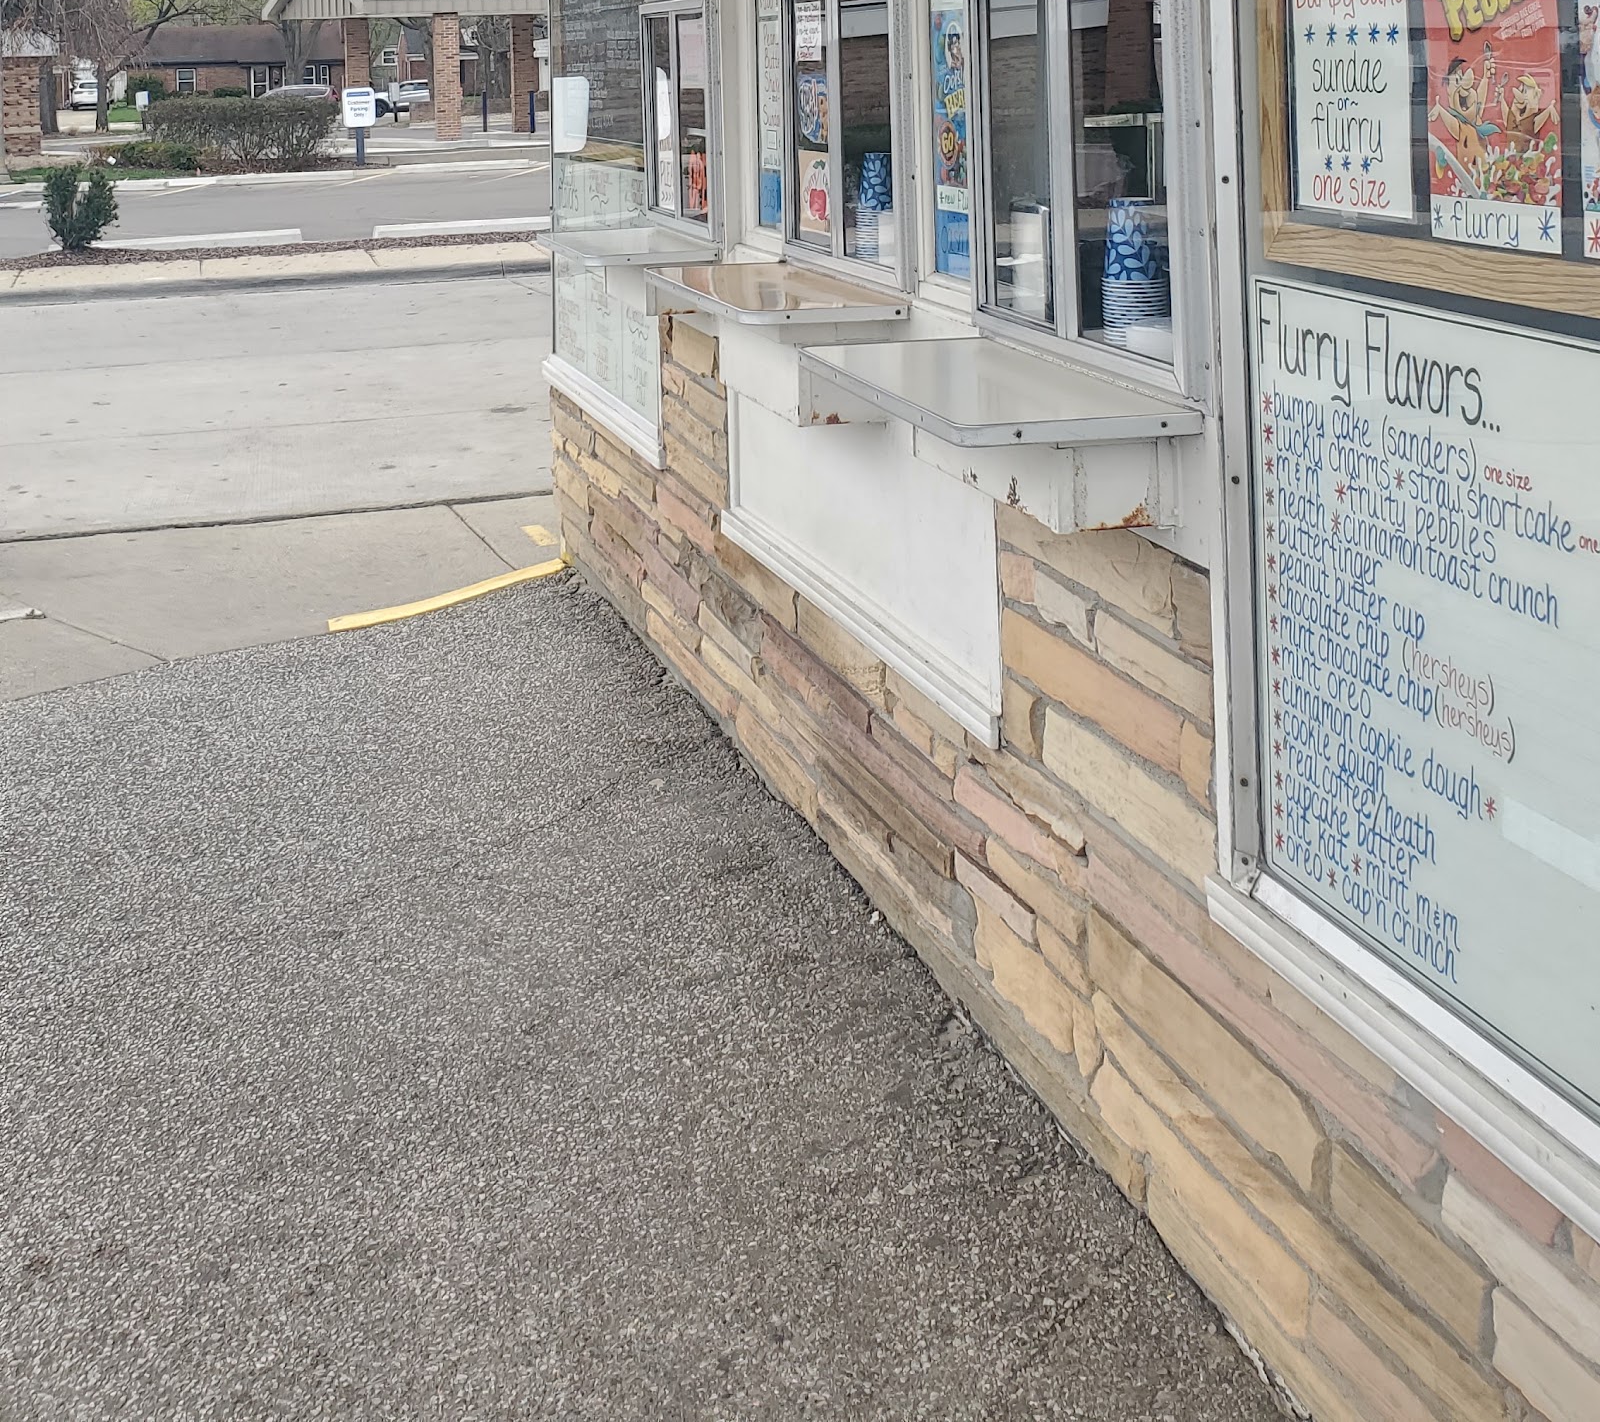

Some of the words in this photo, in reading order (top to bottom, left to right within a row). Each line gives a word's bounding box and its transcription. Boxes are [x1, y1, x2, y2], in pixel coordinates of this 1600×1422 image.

[1311, 48, 1389, 95] sundae
[1311, 99, 1384, 165] flurry
[1312, 172, 1348, 206] one
[1349, 172, 1392, 210] size
[1450, 200, 1520, 247] flurry
[1258, 287, 1352, 407] Flurry
[1272, 379, 1326, 440] bumpy
[1332, 404, 1372, 448] cake
[1381, 414, 1477, 489] (sanders)
[1484, 464, 1503, 485] one
[1505, 467, 1532, 492] size
[1273, 421, 1324, 471] lucky
[1328, 432, 1392, 491] charms
[1467, 481, 1577, 553] shortcake
[1578, 534, 1600, 555] one
[1276, 482, 1328, 534] heath
[1342, 512, 1426, 576] cinnamon
[1425, 542, 1484, 600] toast
[1488, 570, 1560, 630] crunch
[1277, 518, 1384, 592] butterfinger
[1346, 477, 1408, 536] fruity
[1415, 498, 1498, 565] pebbles
[1277, 550, 1331, 602] peanut
[1392, 600, 1427, 651] cup
[1278, 580, 1351, 641] chocolate
[1356, 616, 1391, 666] chip
[1401, 636, 1496, 717] (hersheys)
[1279, 611, 1316, 658] mint
[1318, 626, 1394, 700] chocolate
[1397, 668, 1434, 723] chip
[1433, 683, 1517, 765] (hersheys)
[1280, 642, 1323, 692] mint
[1327, 669, 1373, 720] oreo
[1281, 676, 1354, 745] cinnamon
[1358, 720, 1416, 778] cookie
[1421, 746, 1485, 822] dough
[1282, 709, 1332, 763] cookie
[1335, 734, 1387, 797] dough
[1284, 772, 1351, 838] cupcake
[1356, 810, 1421, 882] batter
[1285, 803, 1313, 847] kit
[1317, 825, 1350, 873] kat
[1365, 858, 1411, 916] mint
[1286, 835, 1324, 883] oreo
[1342, 874, 1388, 933] cap'n
[1391, 910, 1459, 985] crunch
